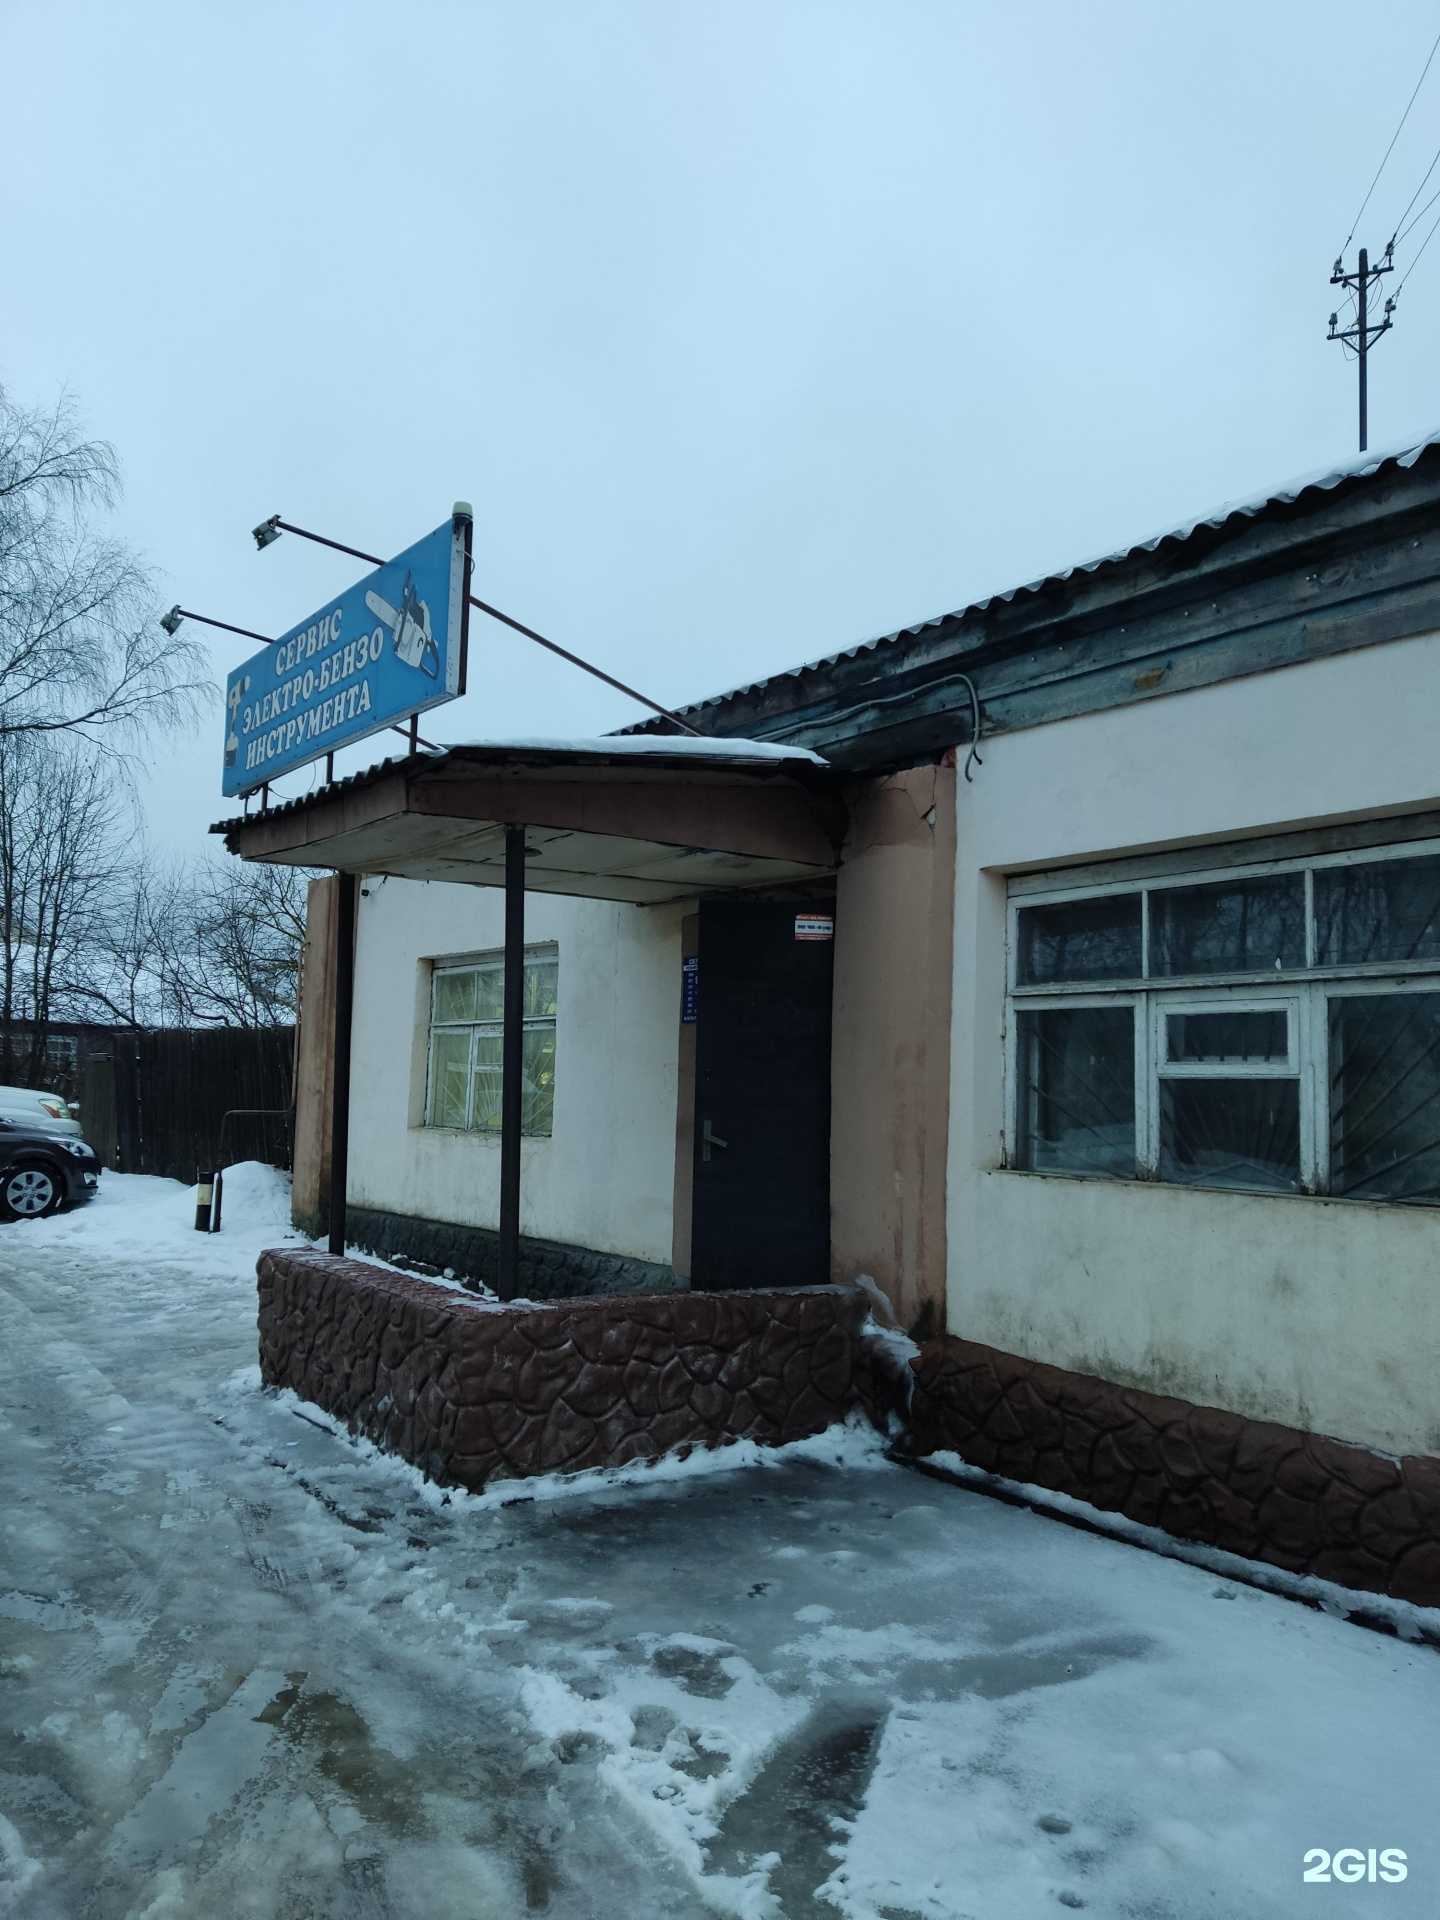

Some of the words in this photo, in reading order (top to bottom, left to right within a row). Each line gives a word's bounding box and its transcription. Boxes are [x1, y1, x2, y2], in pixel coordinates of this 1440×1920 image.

[242, 626, 384, 734] ЭЛЕКТРО-БЕНЗО
[275, 608, 343, 676] СЕРВИС
[245, 679, 371, 770] ИНСТРУМЕНТА
